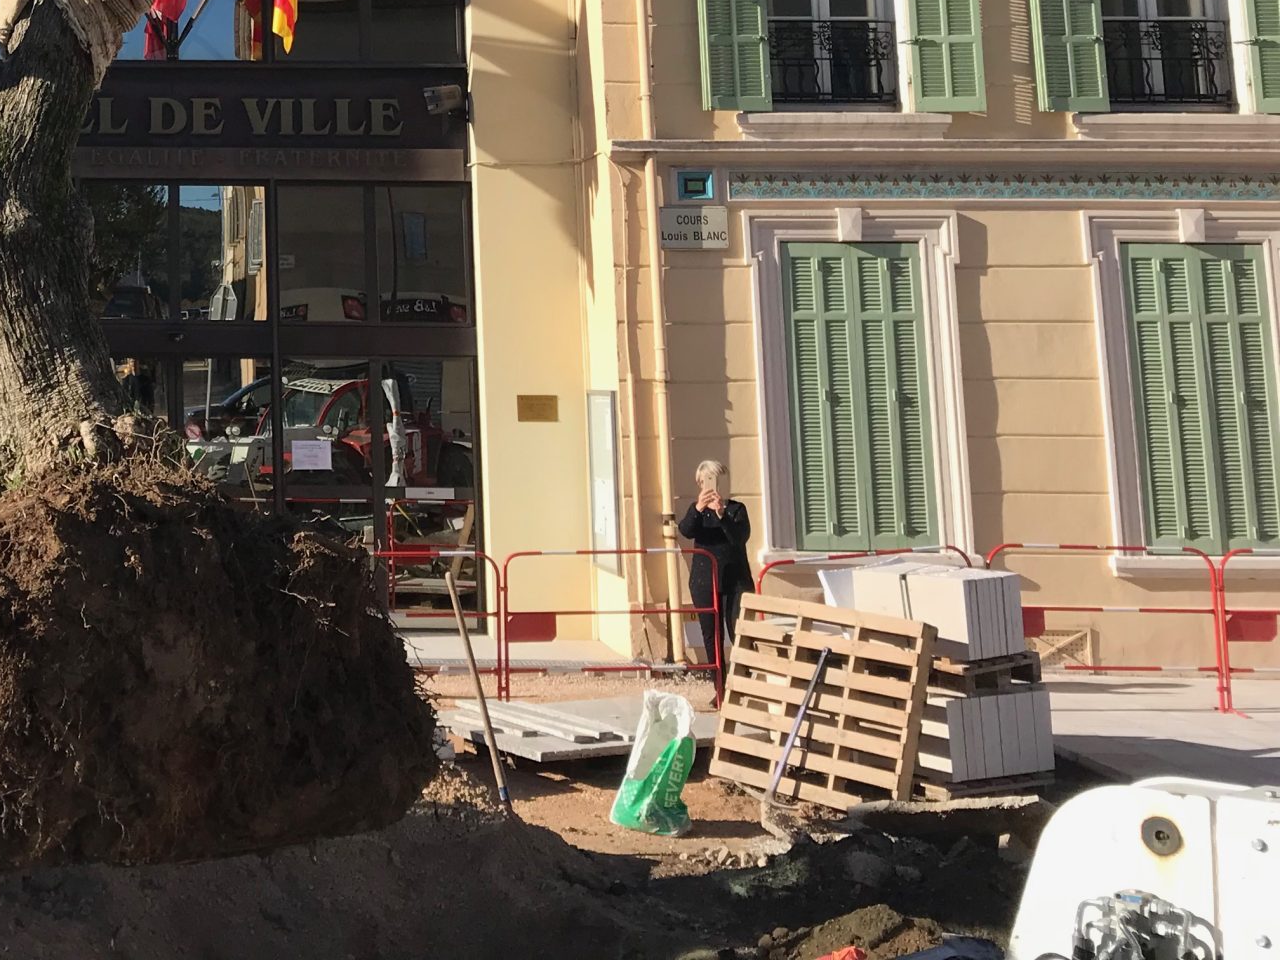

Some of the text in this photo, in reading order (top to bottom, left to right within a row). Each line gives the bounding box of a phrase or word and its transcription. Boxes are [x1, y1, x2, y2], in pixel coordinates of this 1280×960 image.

[148, 97, 224, 135] DE
[241, 98, 404, 136] VILLE
[676, 215, 709, 225] COURS
[661, 231, 727, 241] Louis BLANC
